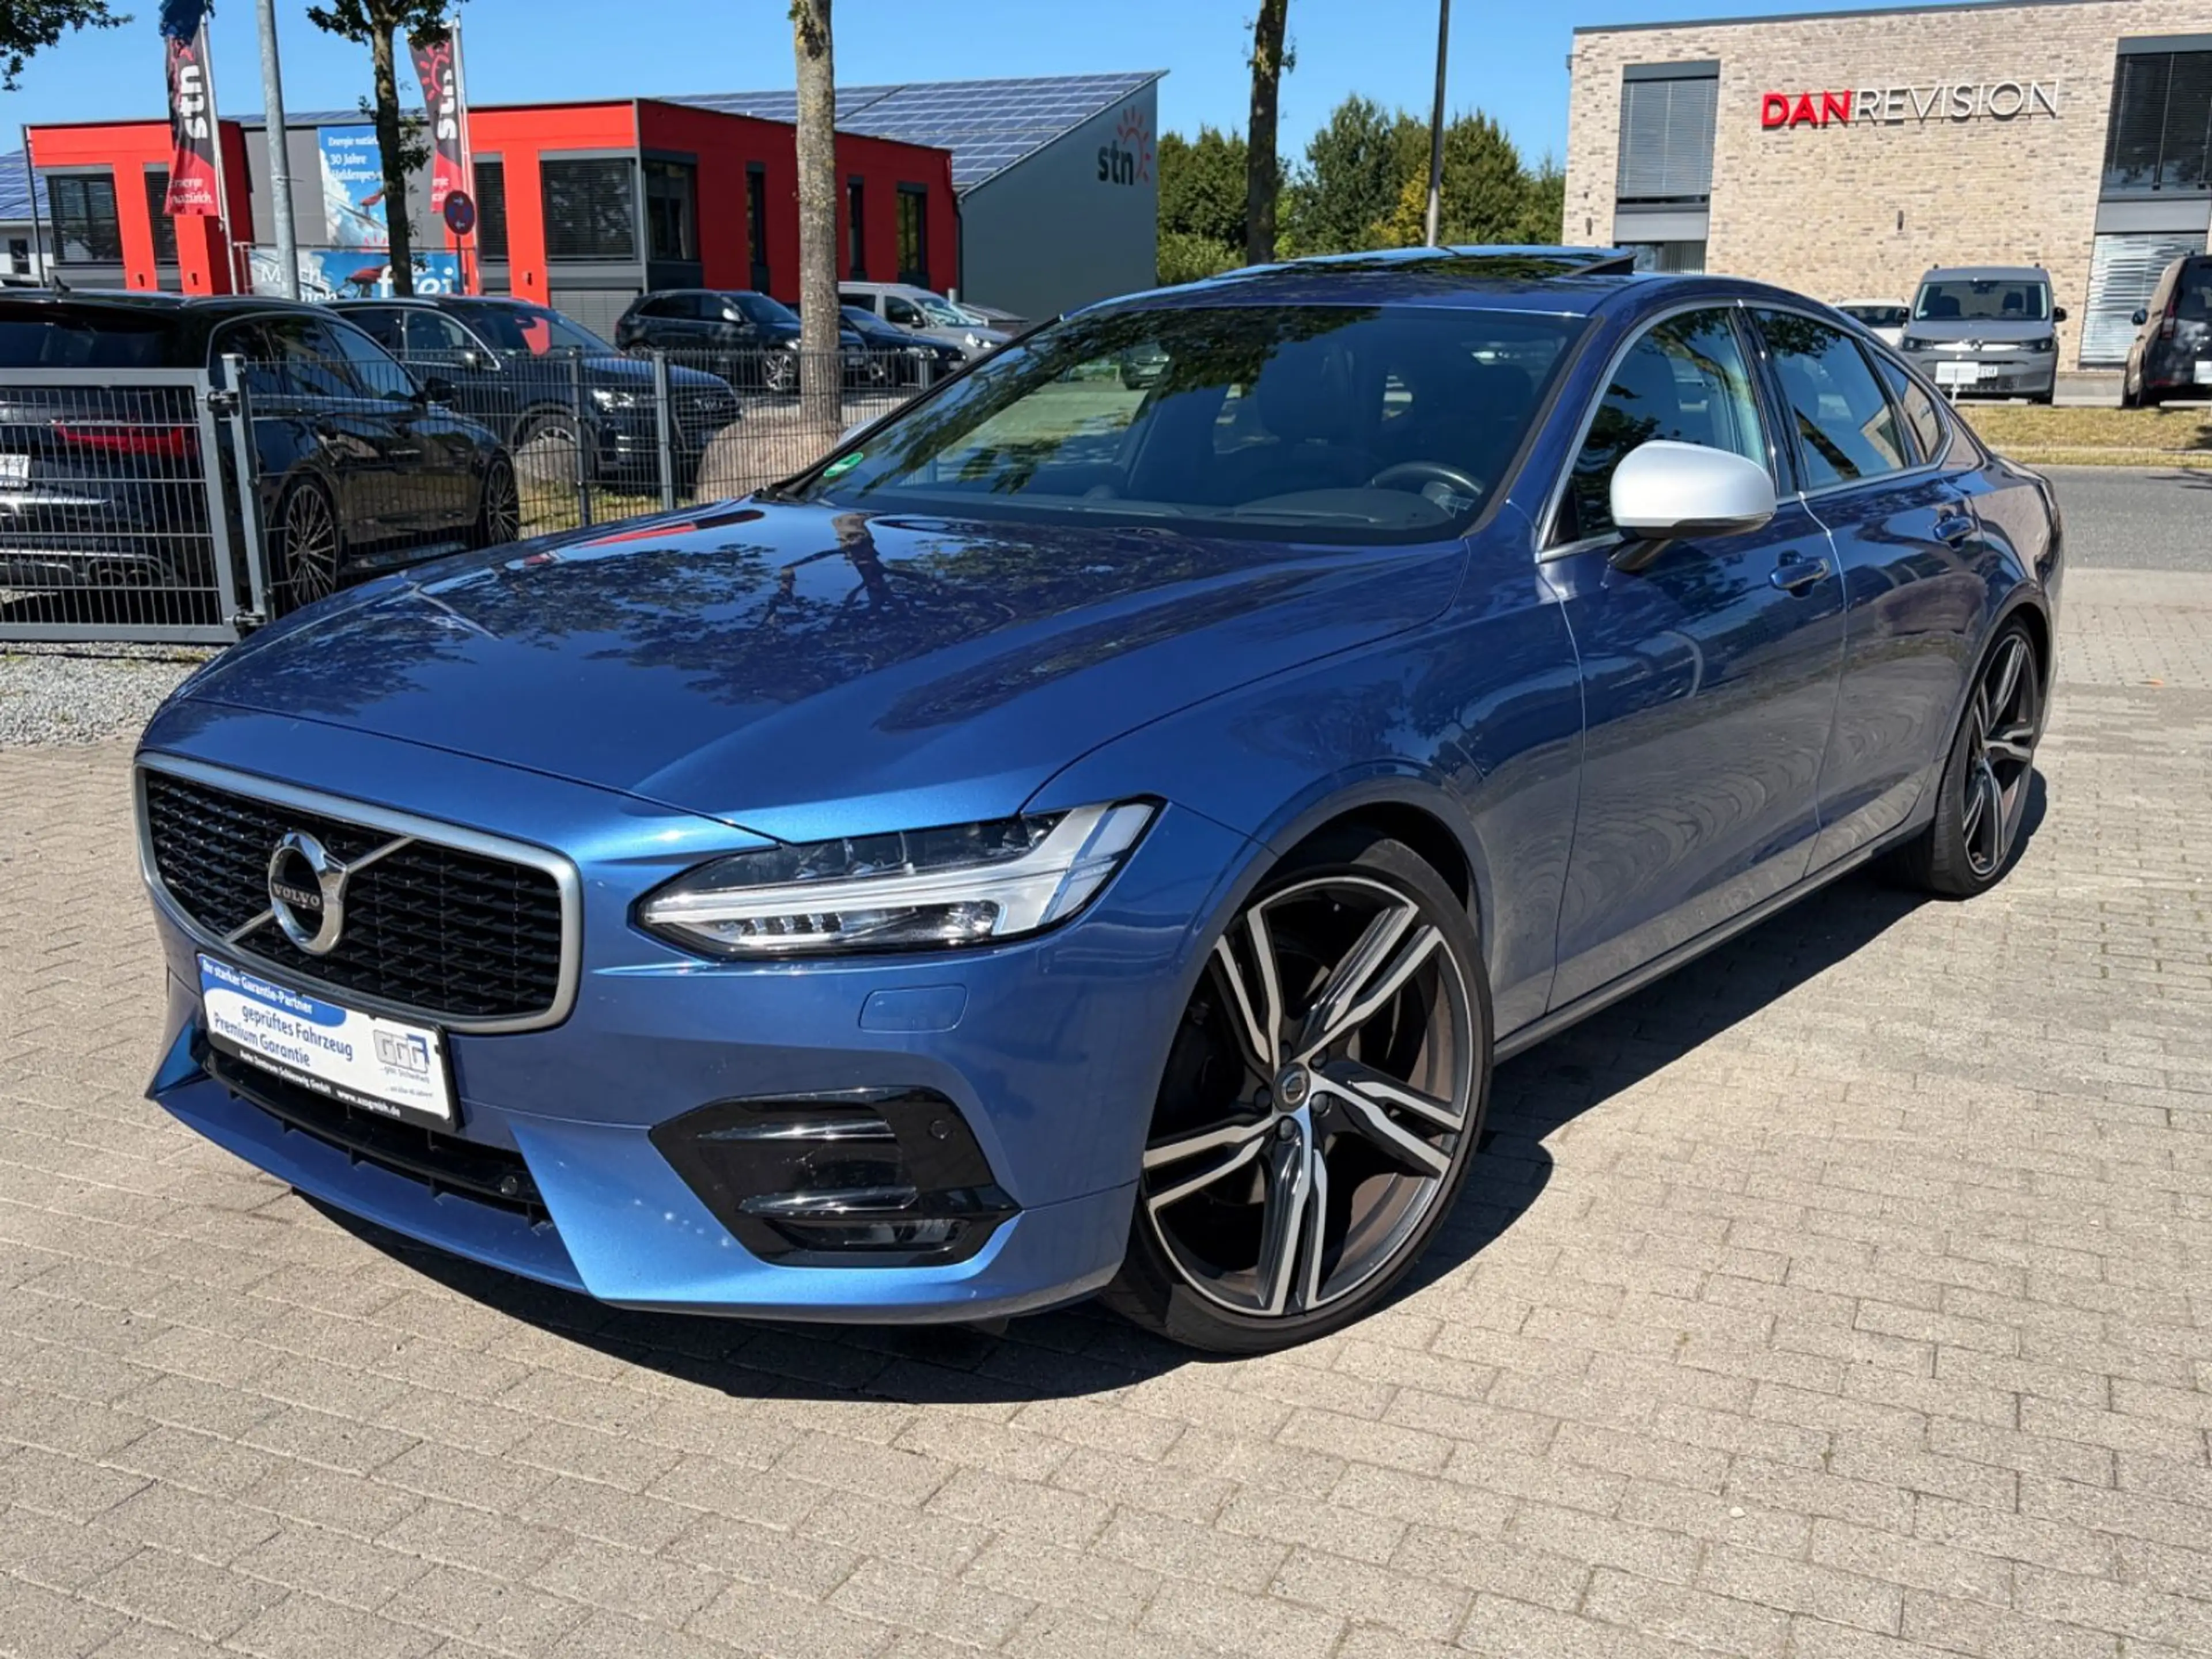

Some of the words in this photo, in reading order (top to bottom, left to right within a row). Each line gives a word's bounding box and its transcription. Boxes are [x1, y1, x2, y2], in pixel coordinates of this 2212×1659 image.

[180, 65, 208, 138] stn
[1762, 79, 2061, 128] DANREVISION
[330, 153, 342, 166] 30
[343, 153, 368, 168] Jahre
[1098, 139, 1134, 185] stn
[262, 264, 321, 283] Mch
[378, 265, 454, 298] fei
[272, 882, 320, 908] VOLVO
[214, 1011, 258, 1046] Premium
[259, 1033, 310, 1067] Garantie
[242, 1005, 294, 1037] geprüftes
[296, 1022, 353, 1062] Fahrzeug
